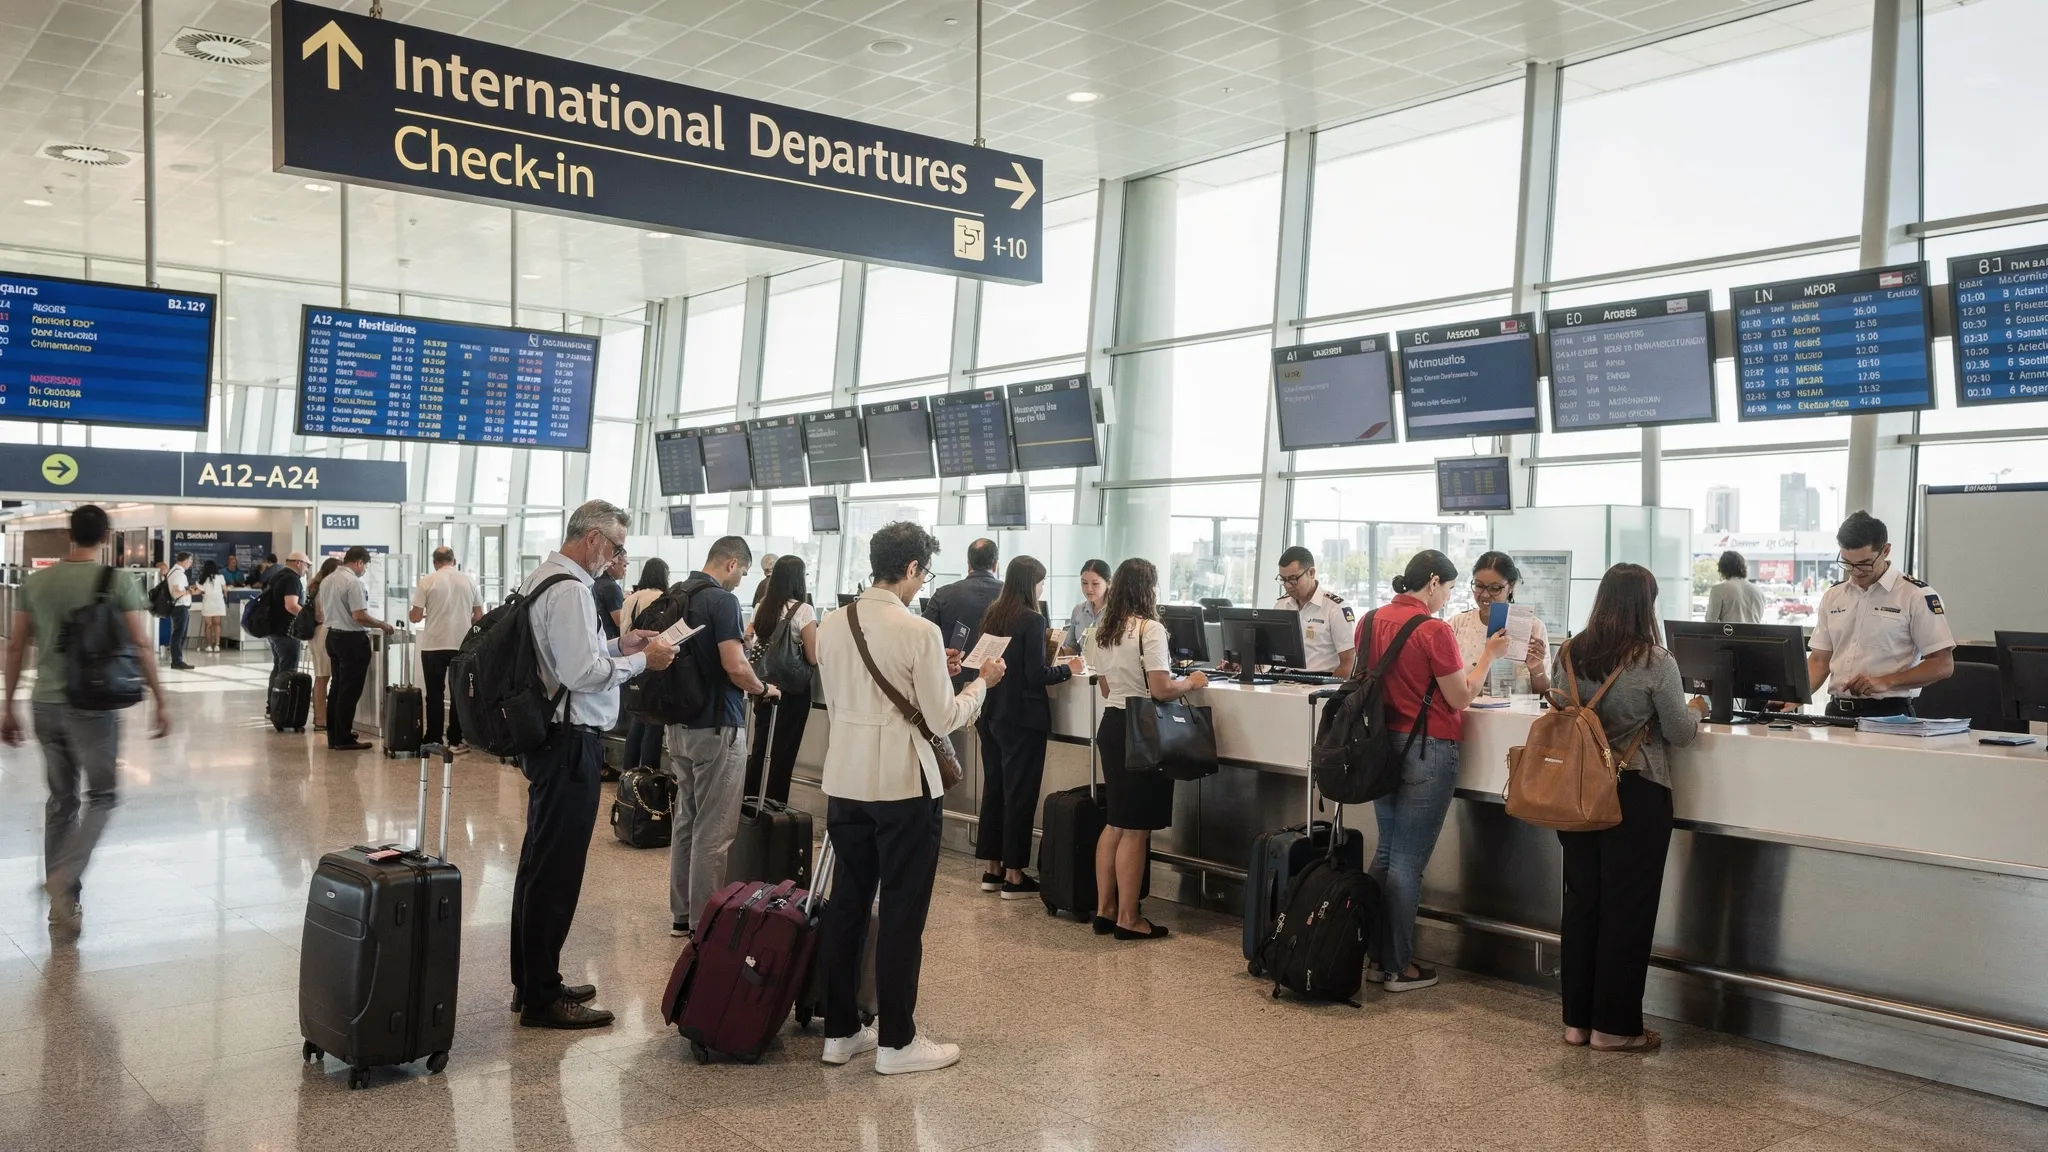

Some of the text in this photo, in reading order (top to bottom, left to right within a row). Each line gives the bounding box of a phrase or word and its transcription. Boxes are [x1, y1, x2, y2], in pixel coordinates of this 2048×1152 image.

[395, 38, 968, 195] International Departures
[394, 125, 594, 198] Check-in
[1755, 288, 1773, 304] LN
[312, 314, 333, 326] A12
[197, 462, 320, 490] A12-A24
